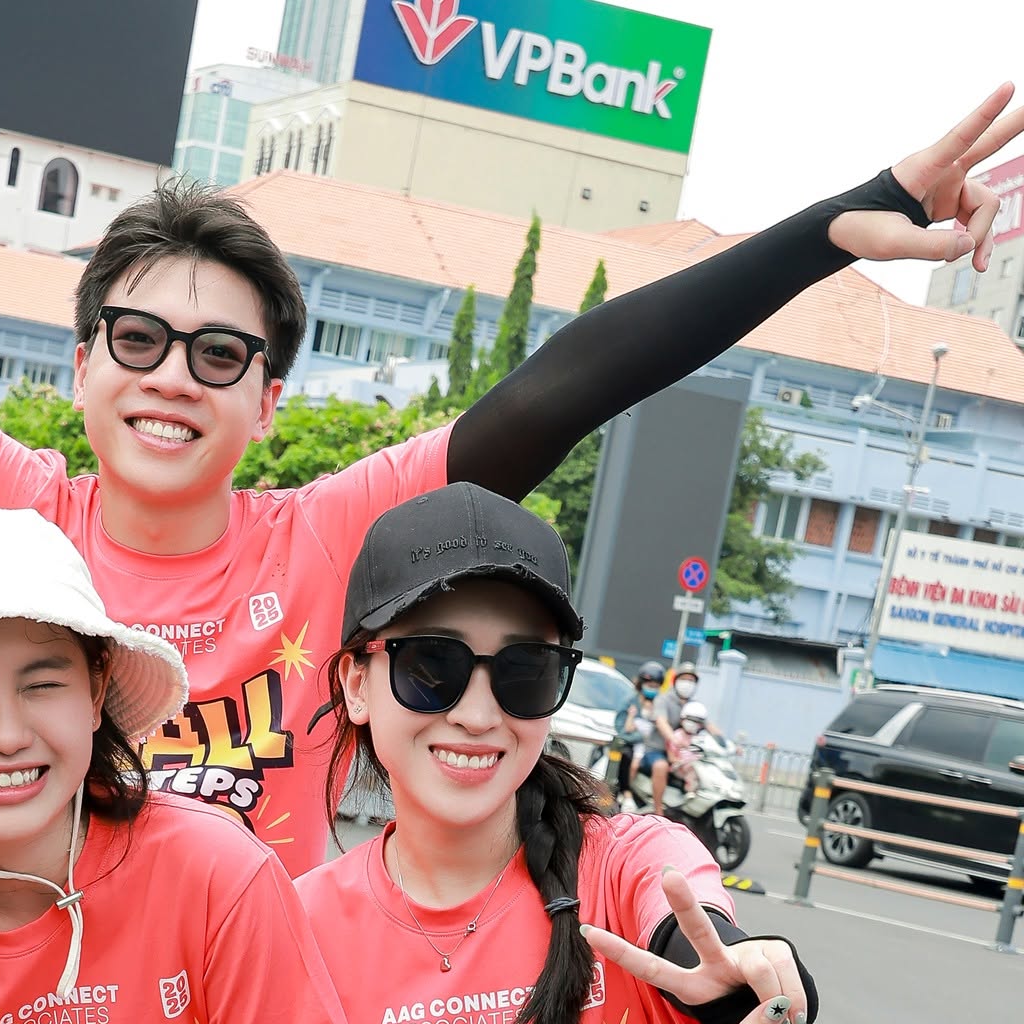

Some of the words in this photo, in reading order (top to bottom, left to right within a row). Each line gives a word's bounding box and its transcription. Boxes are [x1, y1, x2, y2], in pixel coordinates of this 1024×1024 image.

[481, 21, 678, 120] VPBank
[436, 535, 468, 556] good
[494, 540, 514, 553] see
[517, 547, 539, 566] you
[891, 605, 929, 622] SAIGON
[934, 613, 979, 631] GENERAL
[136, 671, 293, 773] ALL
[18, 984, 119, 1020] CONNECT
